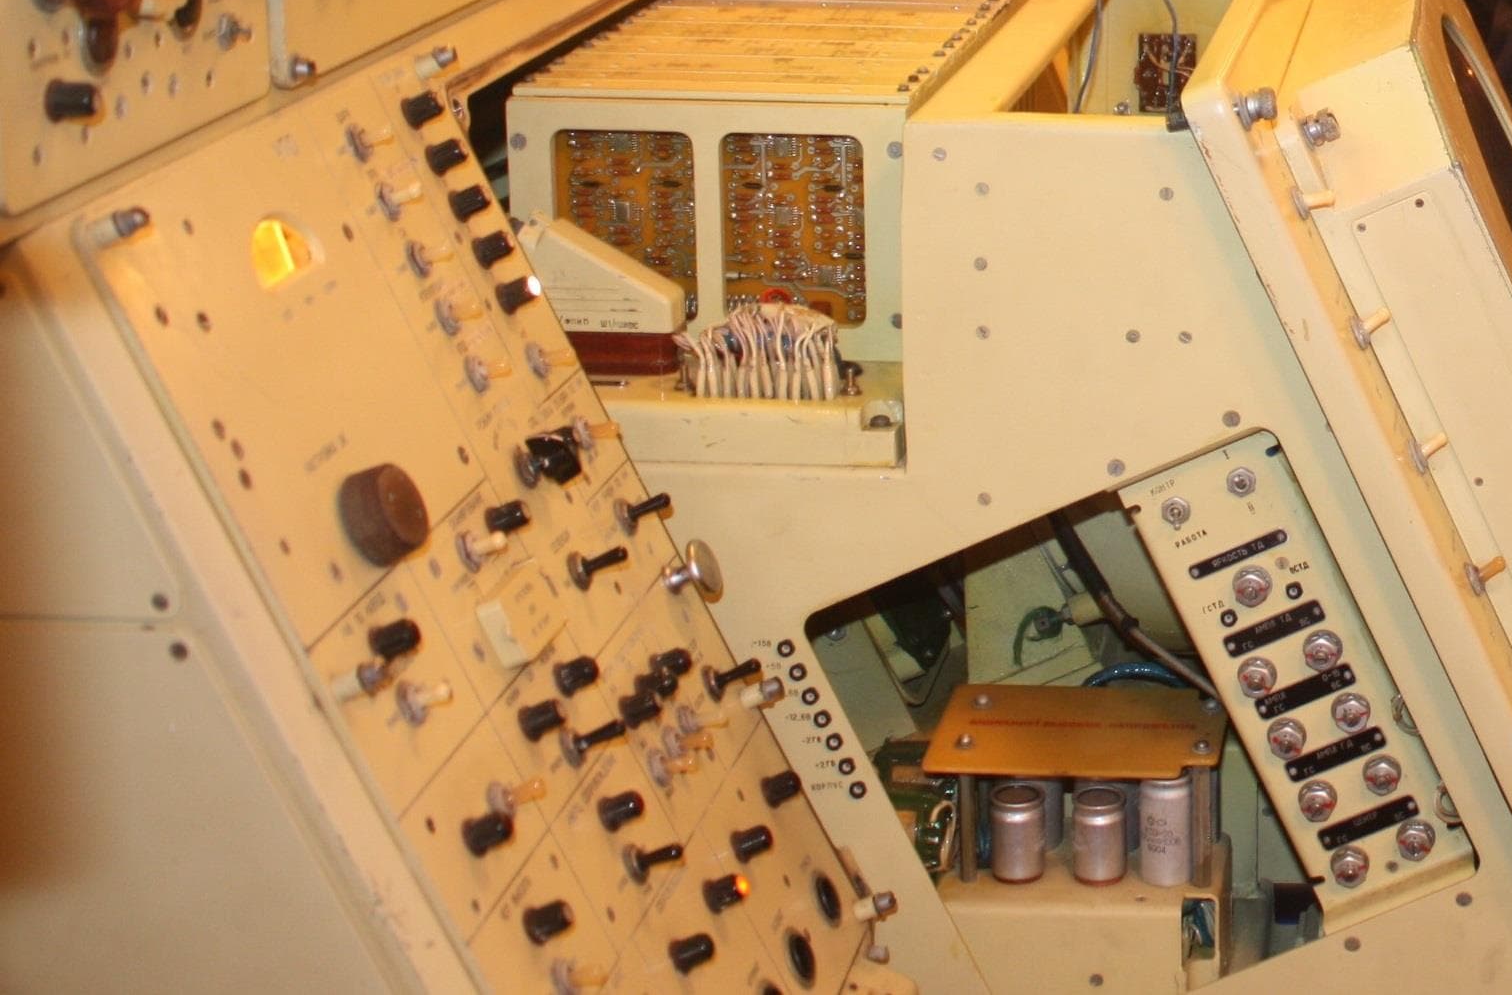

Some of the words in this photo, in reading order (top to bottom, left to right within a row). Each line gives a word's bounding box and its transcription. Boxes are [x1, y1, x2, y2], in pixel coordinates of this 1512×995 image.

[1174, 529, 1207, 549] РАБОТА
[1211, 548, 1248, 568] ЯРКОСТЬ
[811, 780, 845, 792] КОРПУС
